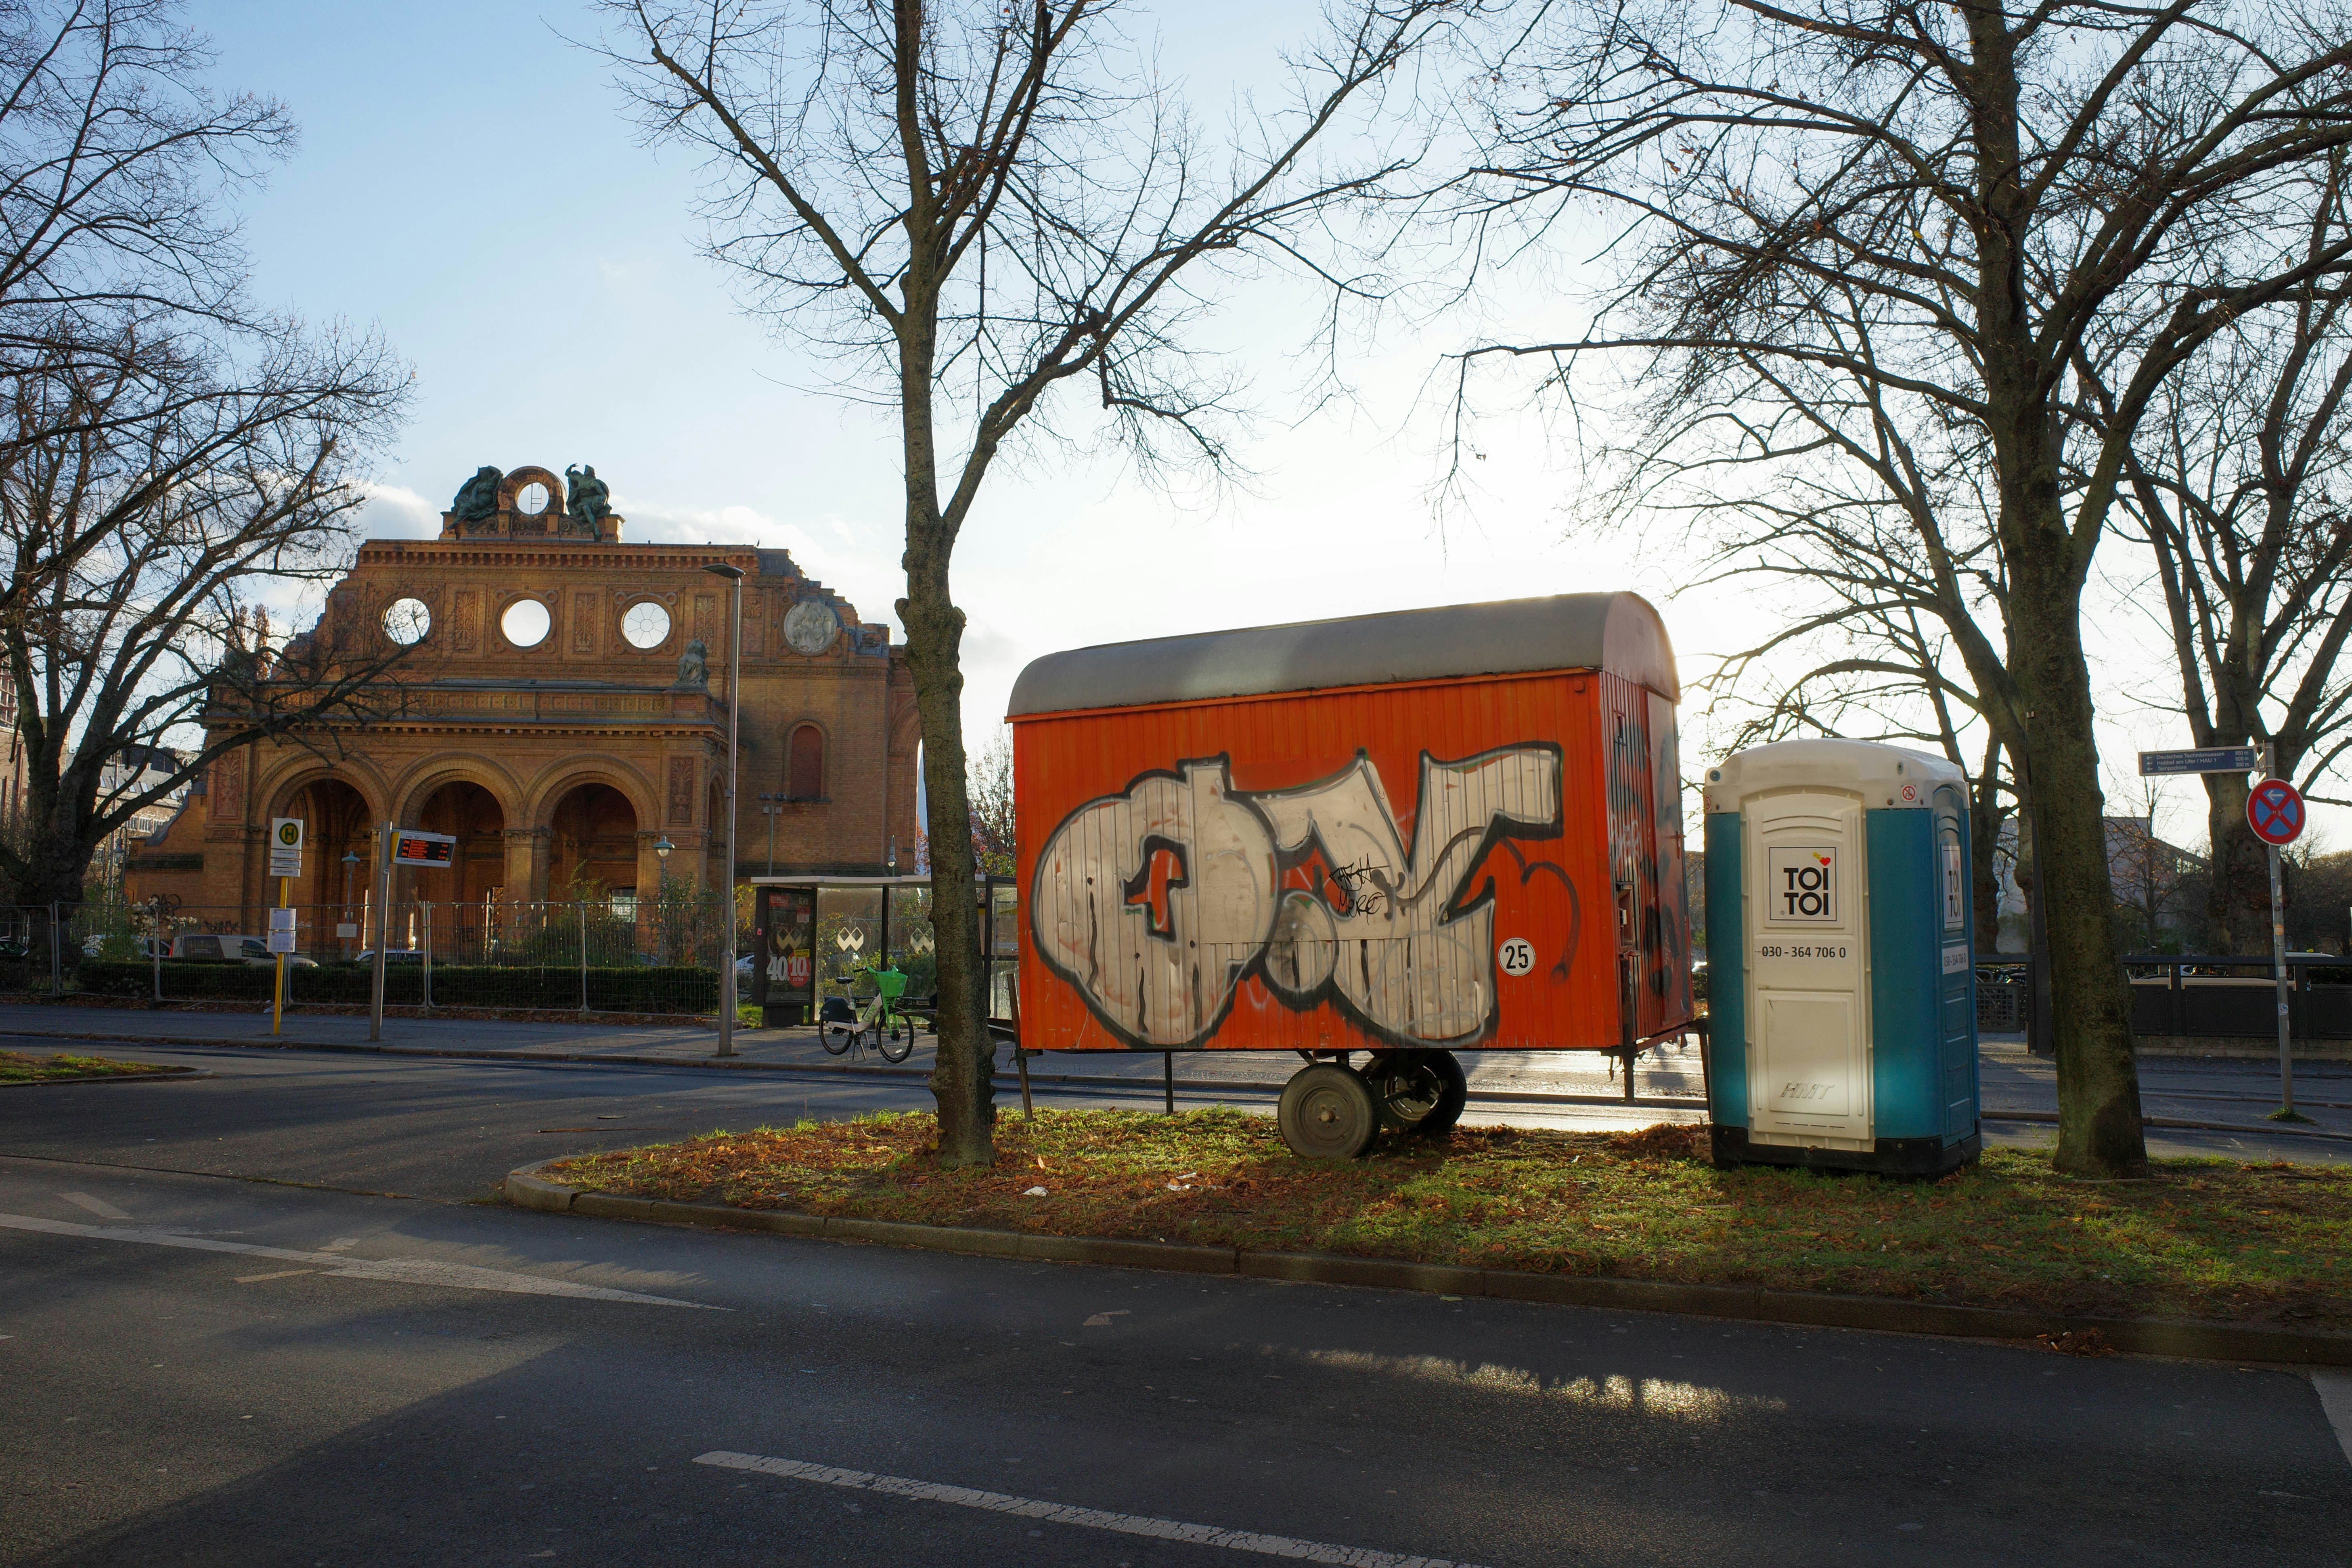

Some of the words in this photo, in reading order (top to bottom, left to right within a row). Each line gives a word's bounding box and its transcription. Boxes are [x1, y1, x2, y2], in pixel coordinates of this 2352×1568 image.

[285, 828, 294, 840] H
[1783, 867, 1828, 891] TOI
[1949, 870, 1960, 893] TOI
[1784, 892, 1829, 915] TOI
[1950, 894, 1960, 917] TOI
[1505, 945, 1529, 969] 25
[1762, 946, 1782, 957] 030
[1791, 946, 1812, 958] 364
[1815, 947, 1836, 958] 706
[1839, 947, 1846, 958] 0
[767, 956, 790, 981] 40%
[863, 1004, 877, 1022] Lime
[1780, 1082, 1835, 1099] HMT
